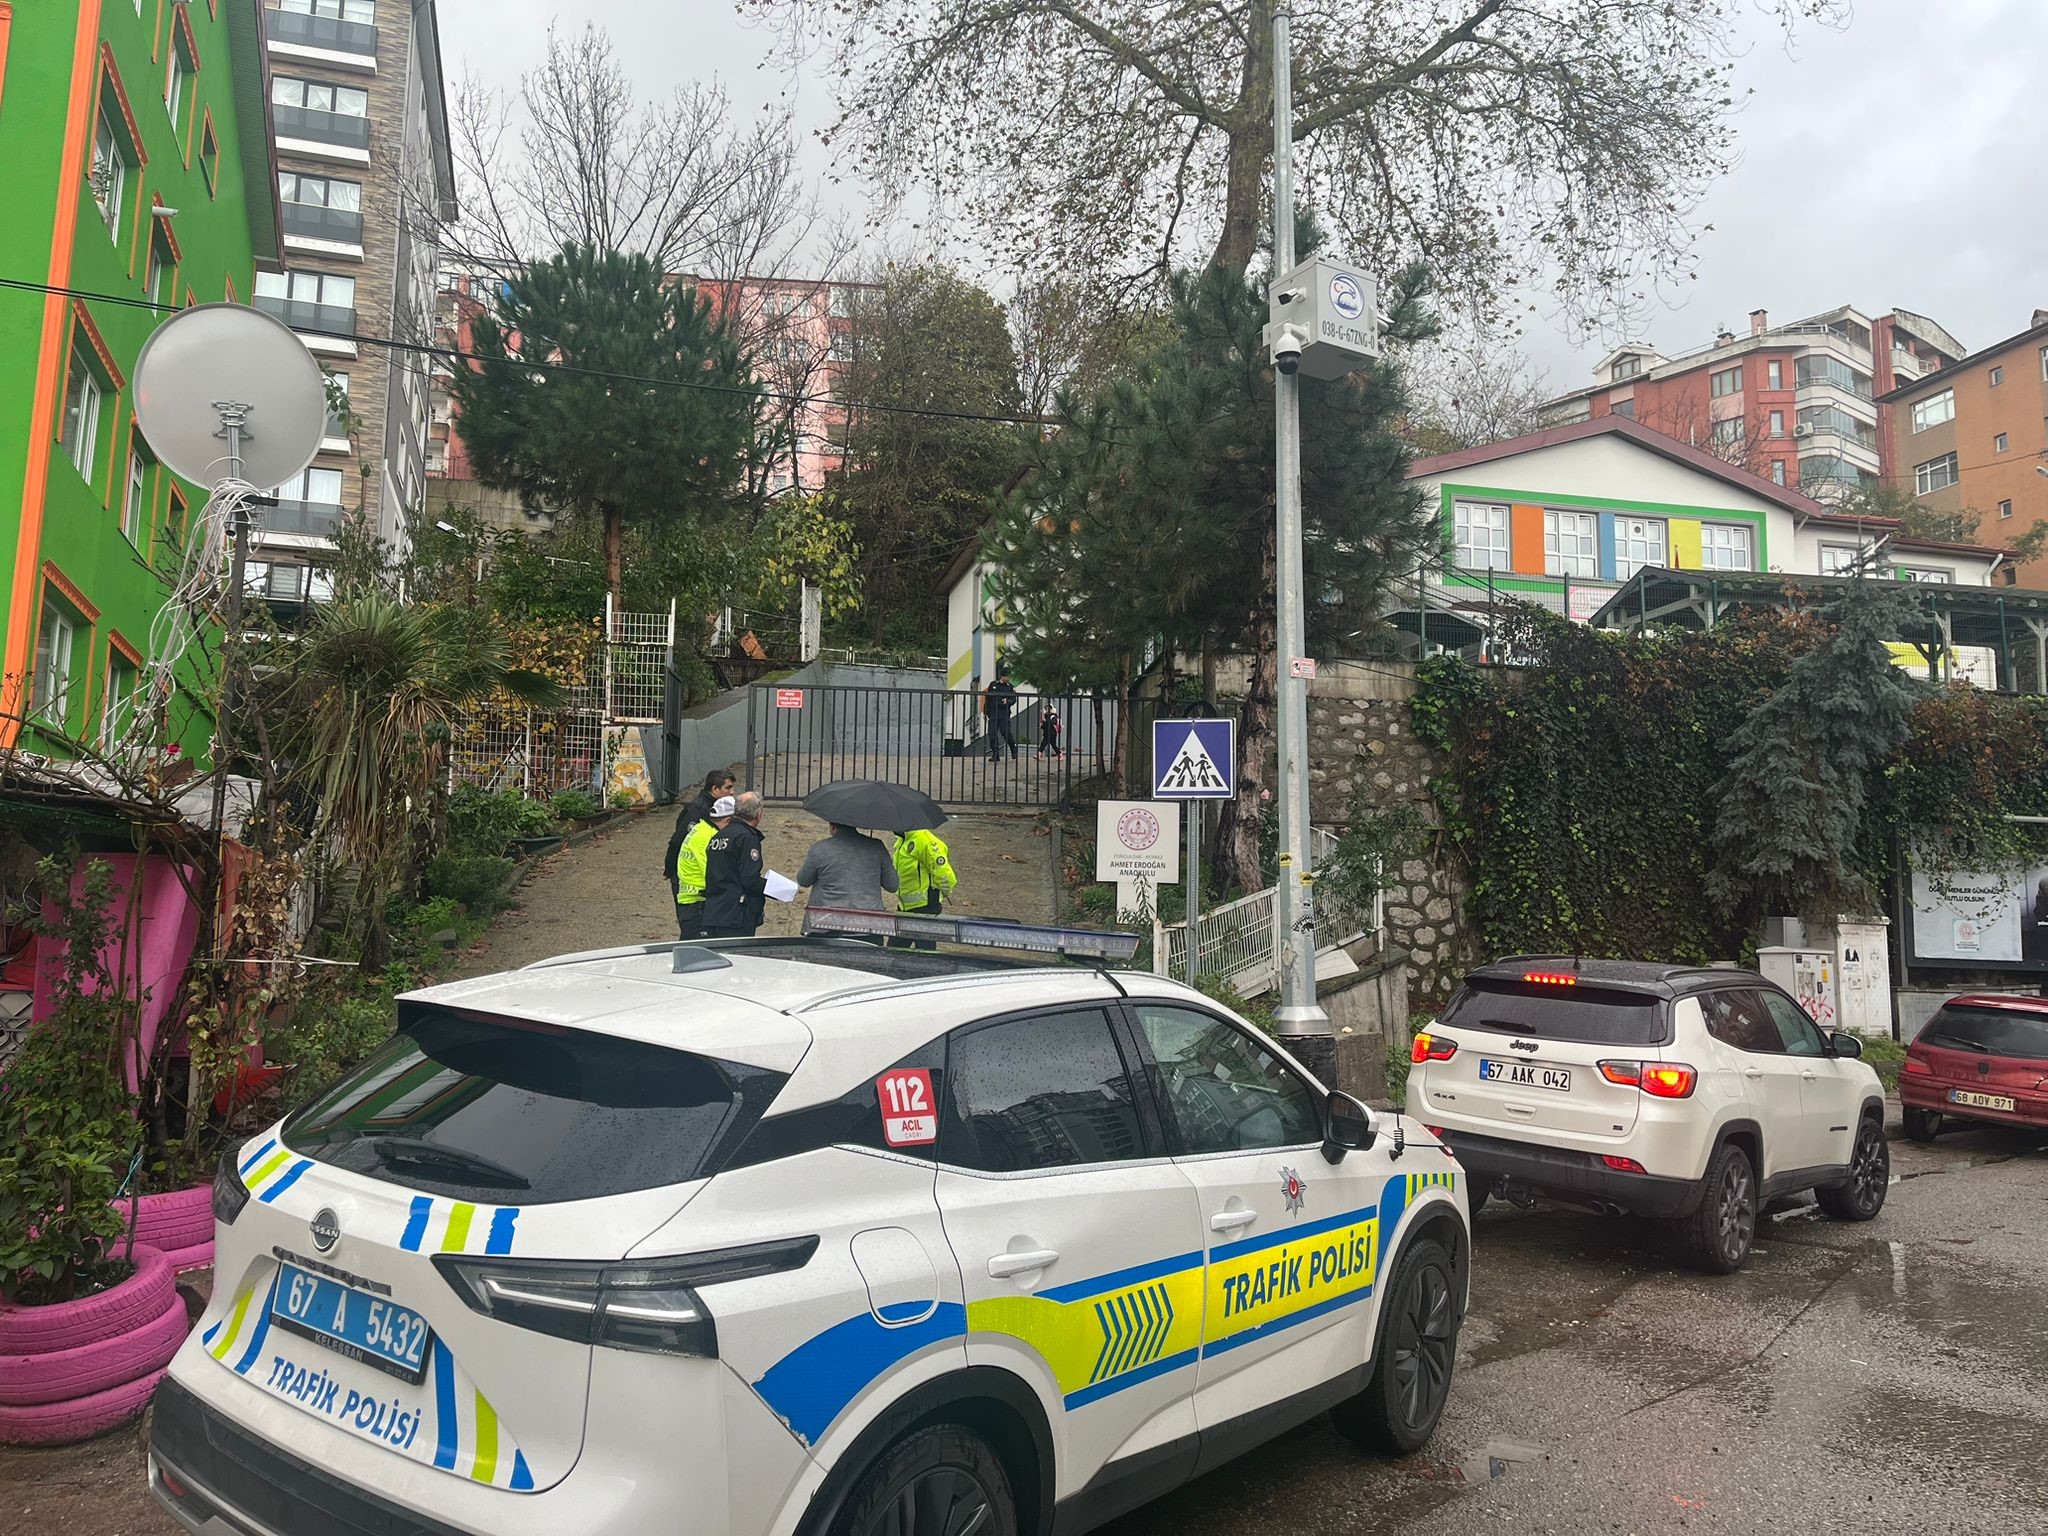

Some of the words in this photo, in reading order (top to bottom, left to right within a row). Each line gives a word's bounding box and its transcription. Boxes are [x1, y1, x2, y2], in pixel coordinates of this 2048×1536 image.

[1119, 869, 1156, 877] ANAOKULU
[1134, 861, 1166, 869] ERDOĞAN
[1510, 1040, 1539, 1053] Jeep
[1488, 1063, 1503, 1079] 67
[1511, 1067, 1535, 1084] AAK
[1543, 1071, 1568, 1088] 042
[885, 1076, 928, 1112] 112
[1433, 1092, 1456, 1100] 4x4
[1956, 1092, 1968, 1103] 68
[1972, 1095, 1990, 1106] ADV
[1994, 1098, 2012, 1109] 971
[310, 1222, 339, 1239] SSAN
[1223, 1248, 1303, 1318] TRAFİK
[1309, 1224, 1371, 1289] POLİSİ
[288, 1273, 318, 1319] 67
[332, 1291, 347, 1333] A
[366, 1301, 425, 1364] 5432
[314, 1332, 364, 1362] KELESSAN
[266, 1356, 340, 1415] TRAFİK
[339, 1388, 422, 1449] POLİSİ
